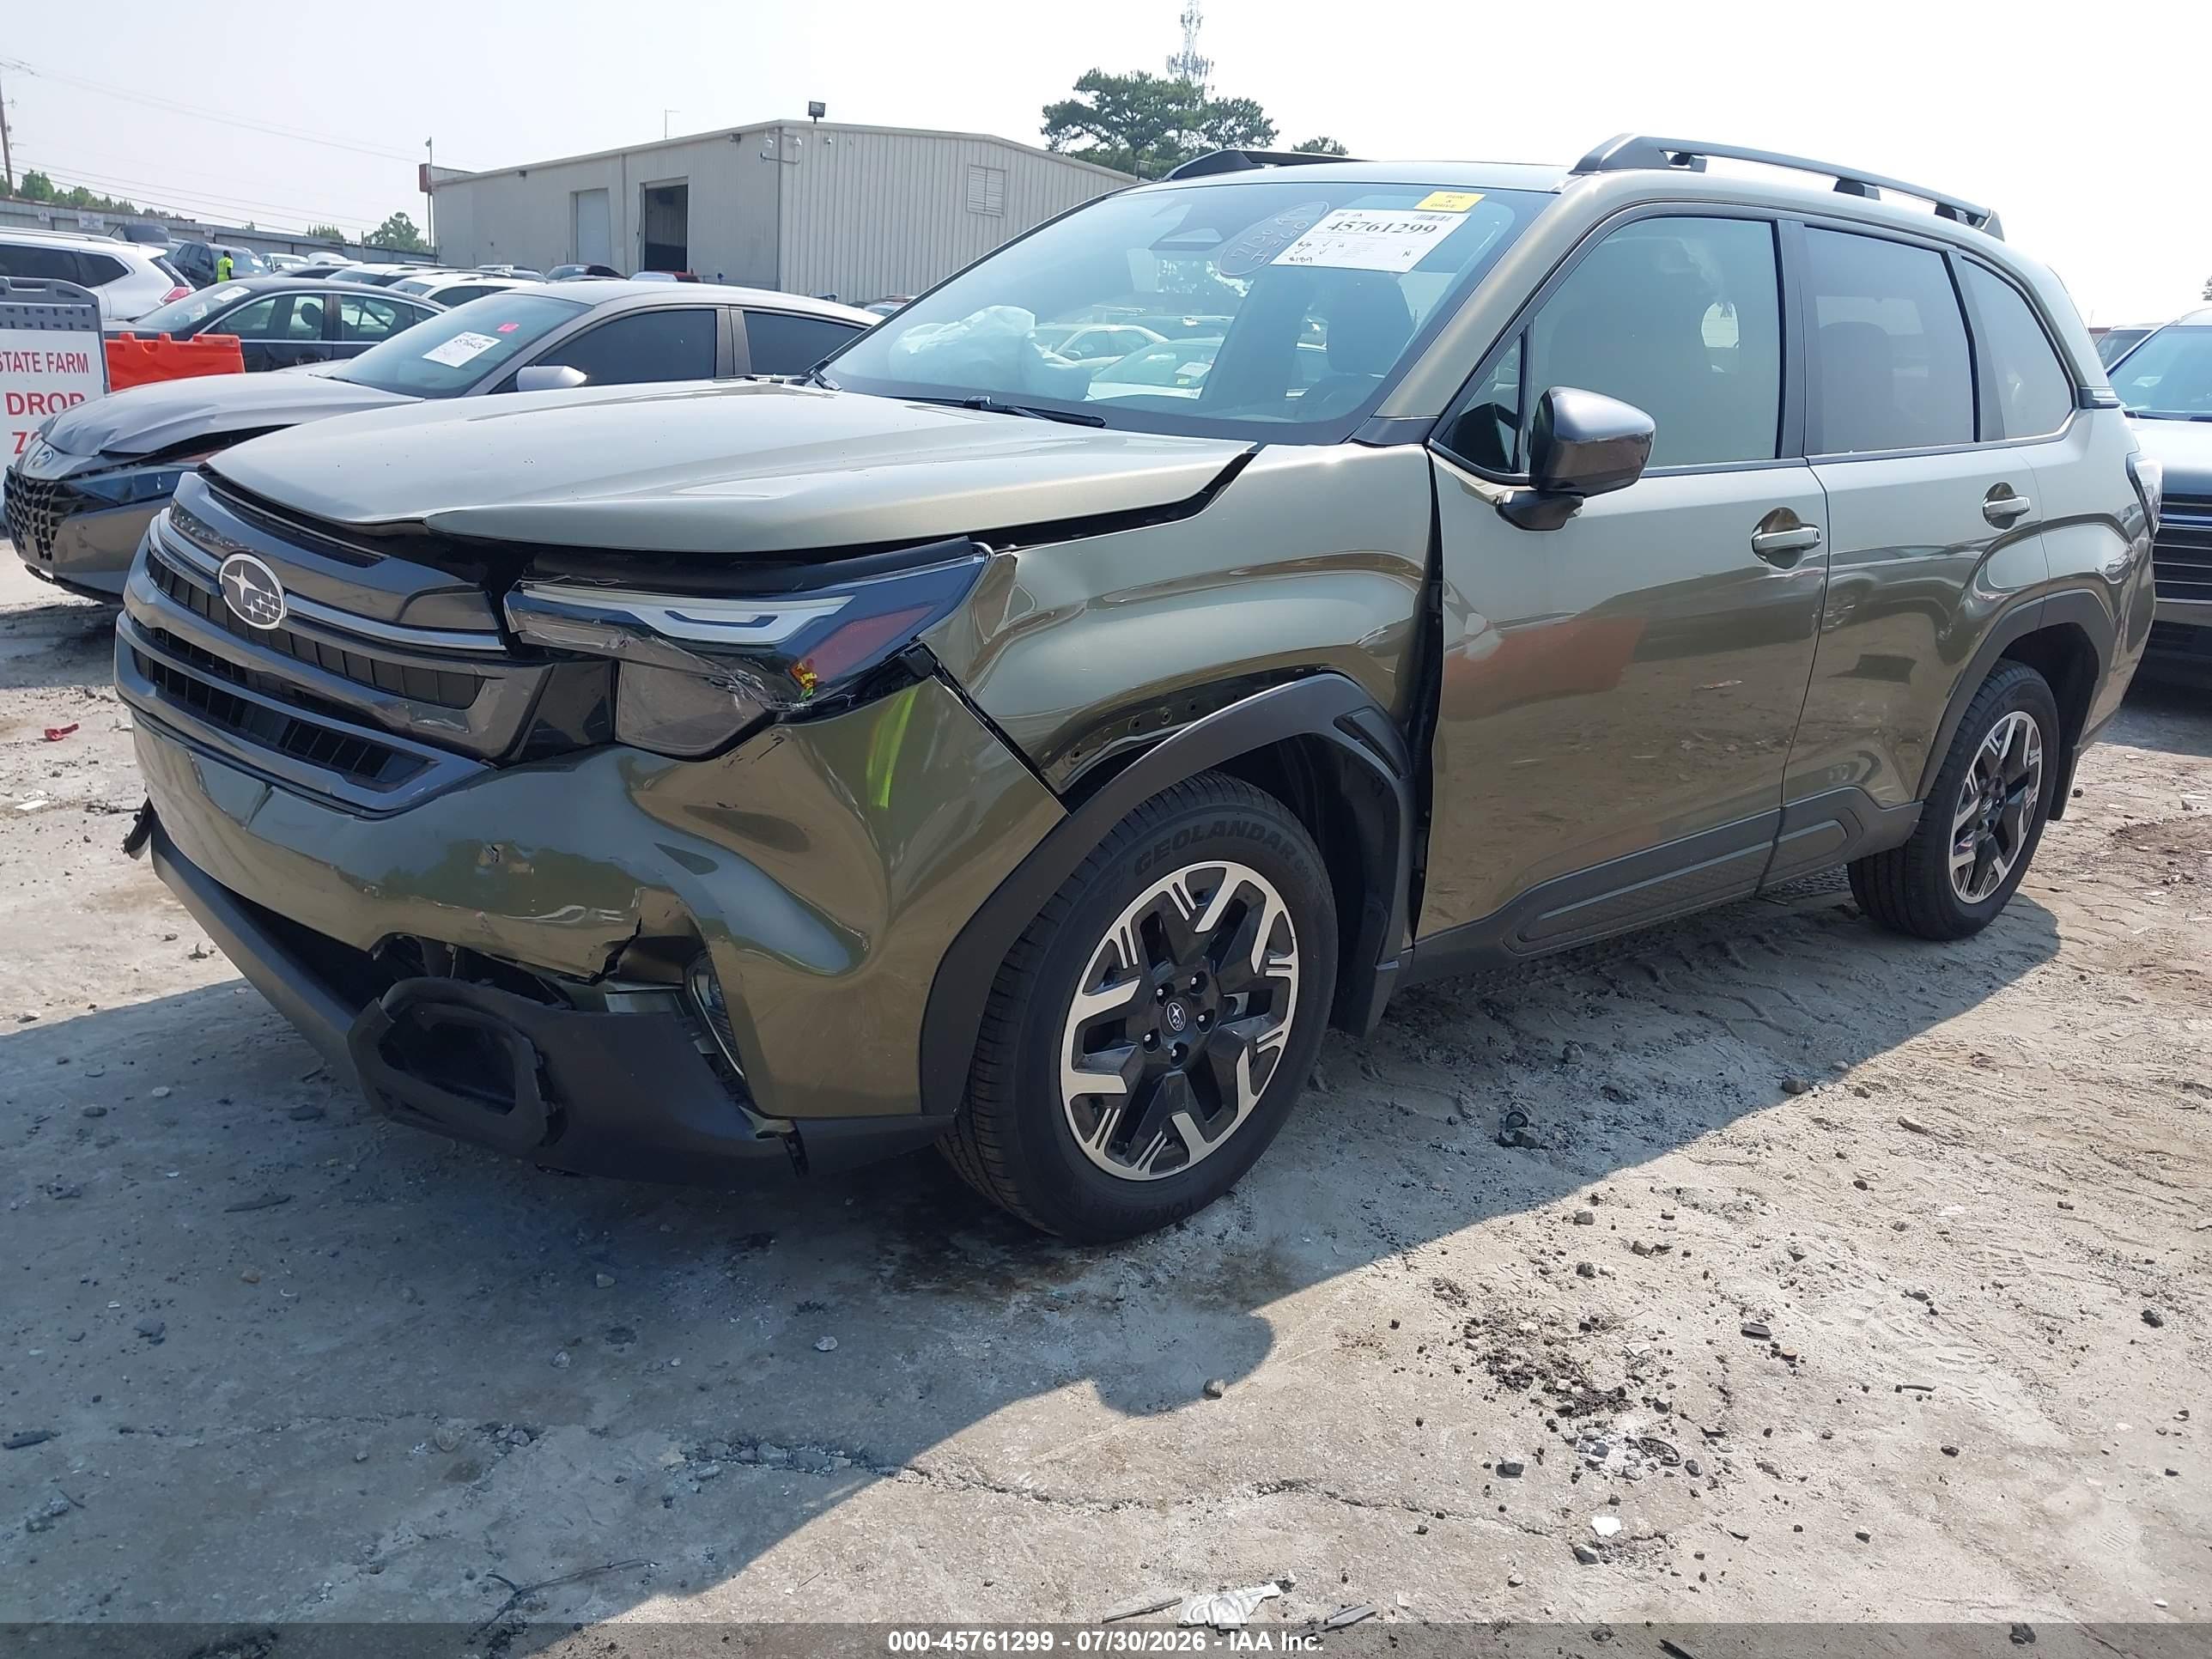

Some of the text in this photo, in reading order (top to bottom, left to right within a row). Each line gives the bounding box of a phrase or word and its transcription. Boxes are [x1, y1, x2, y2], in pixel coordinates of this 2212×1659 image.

[1327, 221, 1437, 234] 45761299
[46, 352, 89, 374] FARM
[1133, 820, 1297, 877] GEOLANDAR
